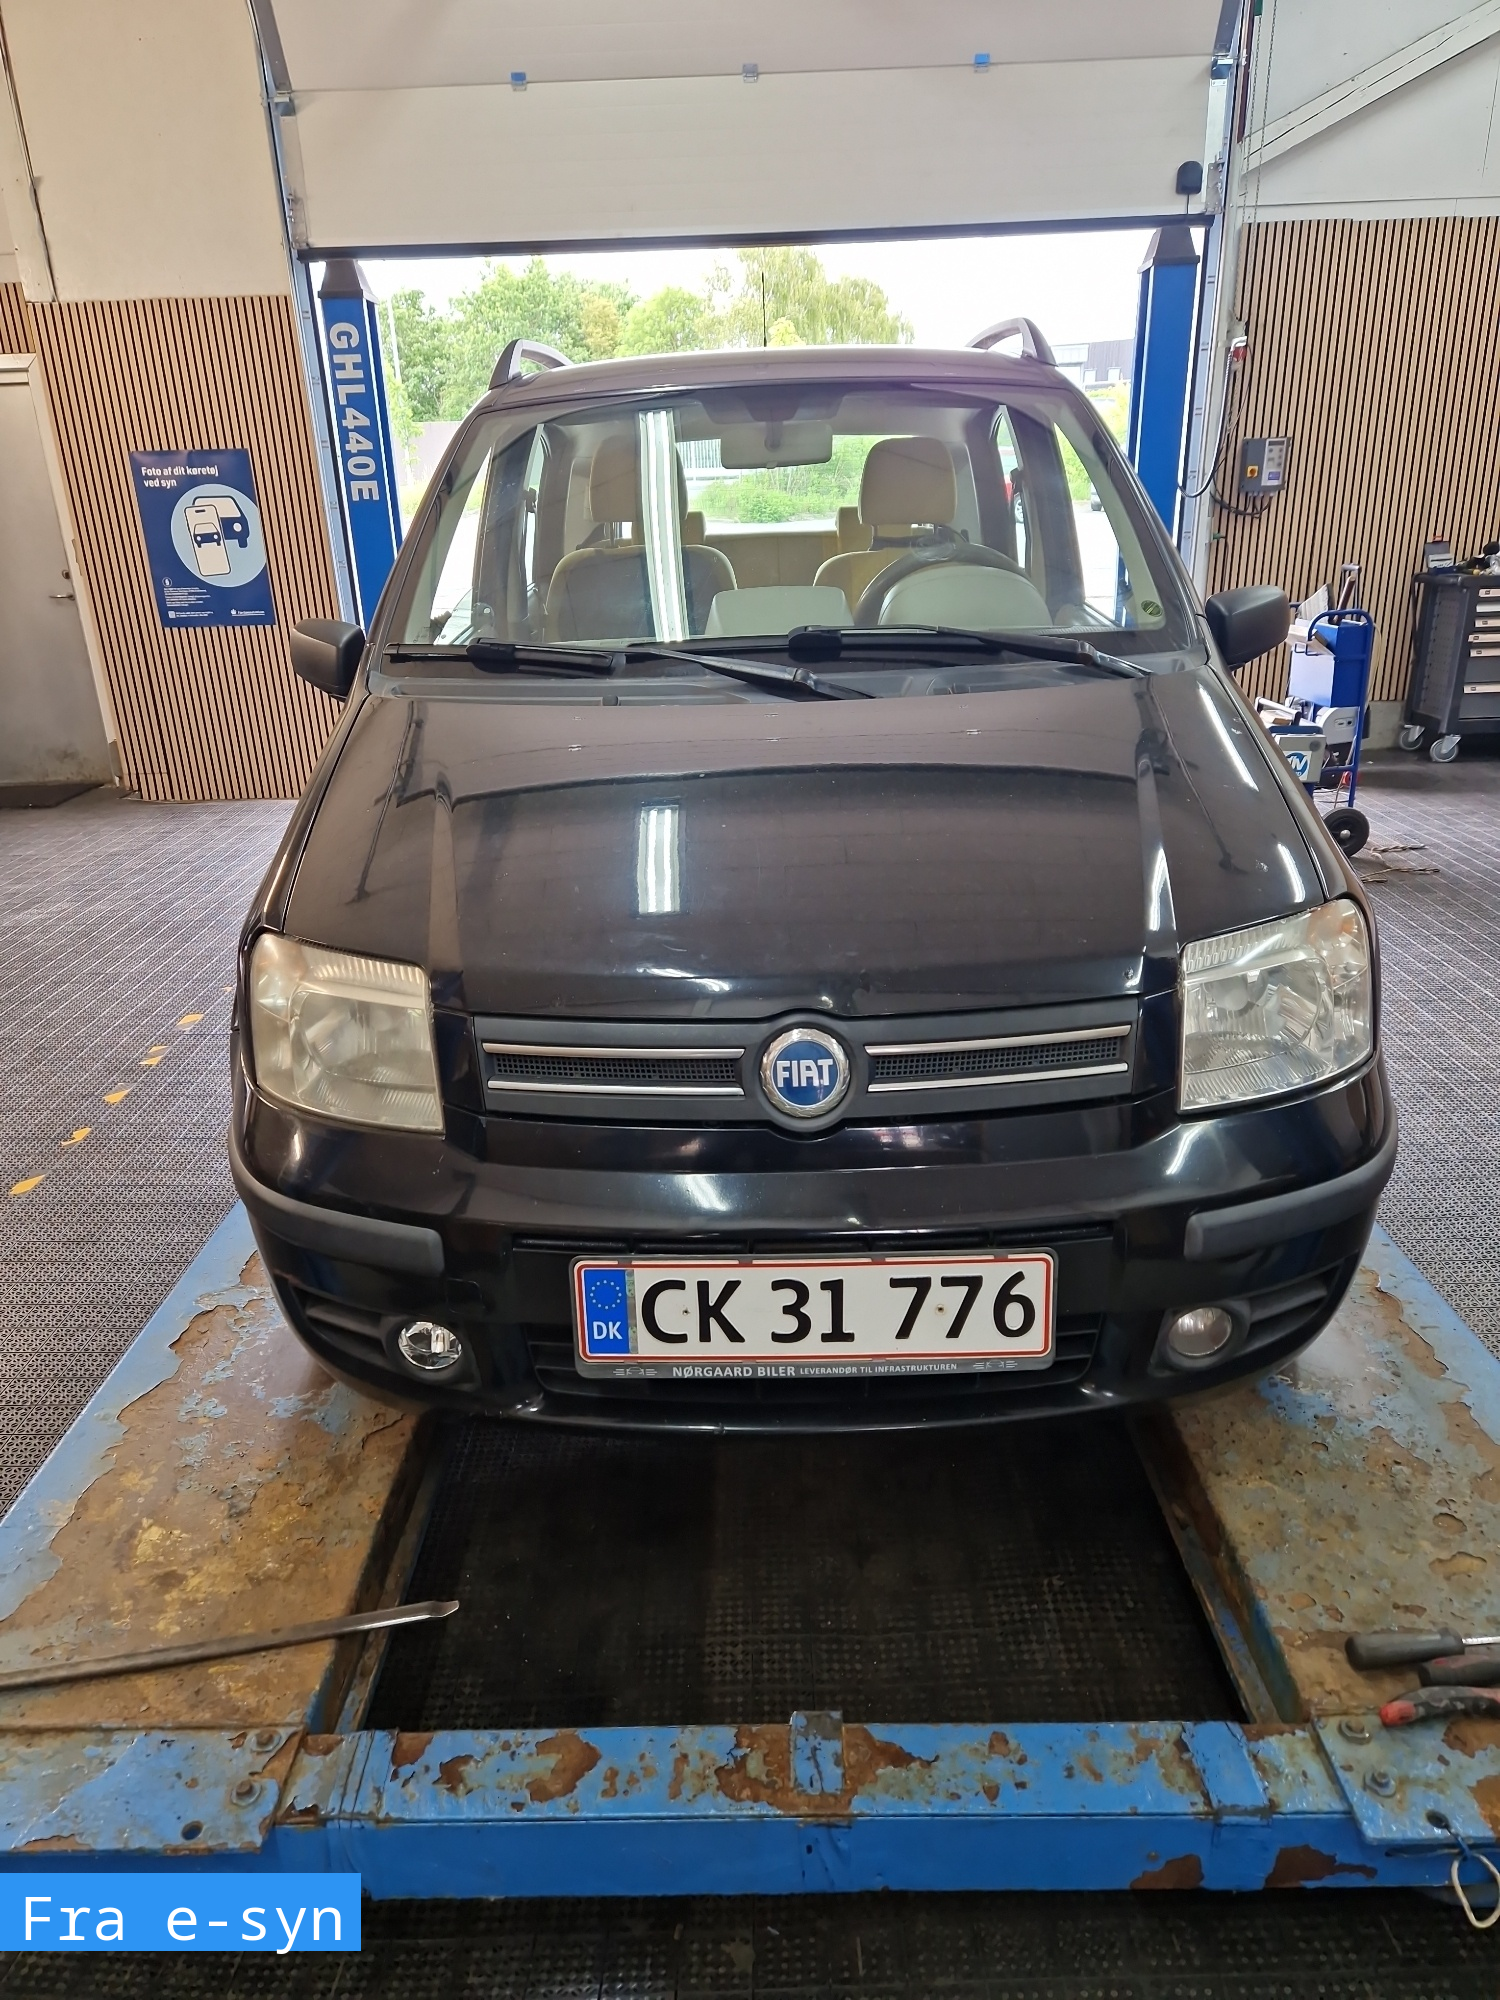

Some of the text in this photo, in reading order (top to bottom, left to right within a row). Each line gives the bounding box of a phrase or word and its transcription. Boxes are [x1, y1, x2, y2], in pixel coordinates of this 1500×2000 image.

[329, 322, 380, 502] GHL440E
[141, 465, 219, 477] Foto af dit køretøj
[143, 478, 177, 489] ved syn
[776, 1059, 834, 1088] FIAT
[641, 1270, 1037, 1343] CK 31 776
[592, 1321, 623, 1340] DK
[672, 1366, 753, 1378] NØRGAARD
[757, 1365, 796, 1377] BILER
[799, 1366, 858, 1376] LEVERANDØR
[874, 1363, 958, 1373] INFRASTRUKTUREN
